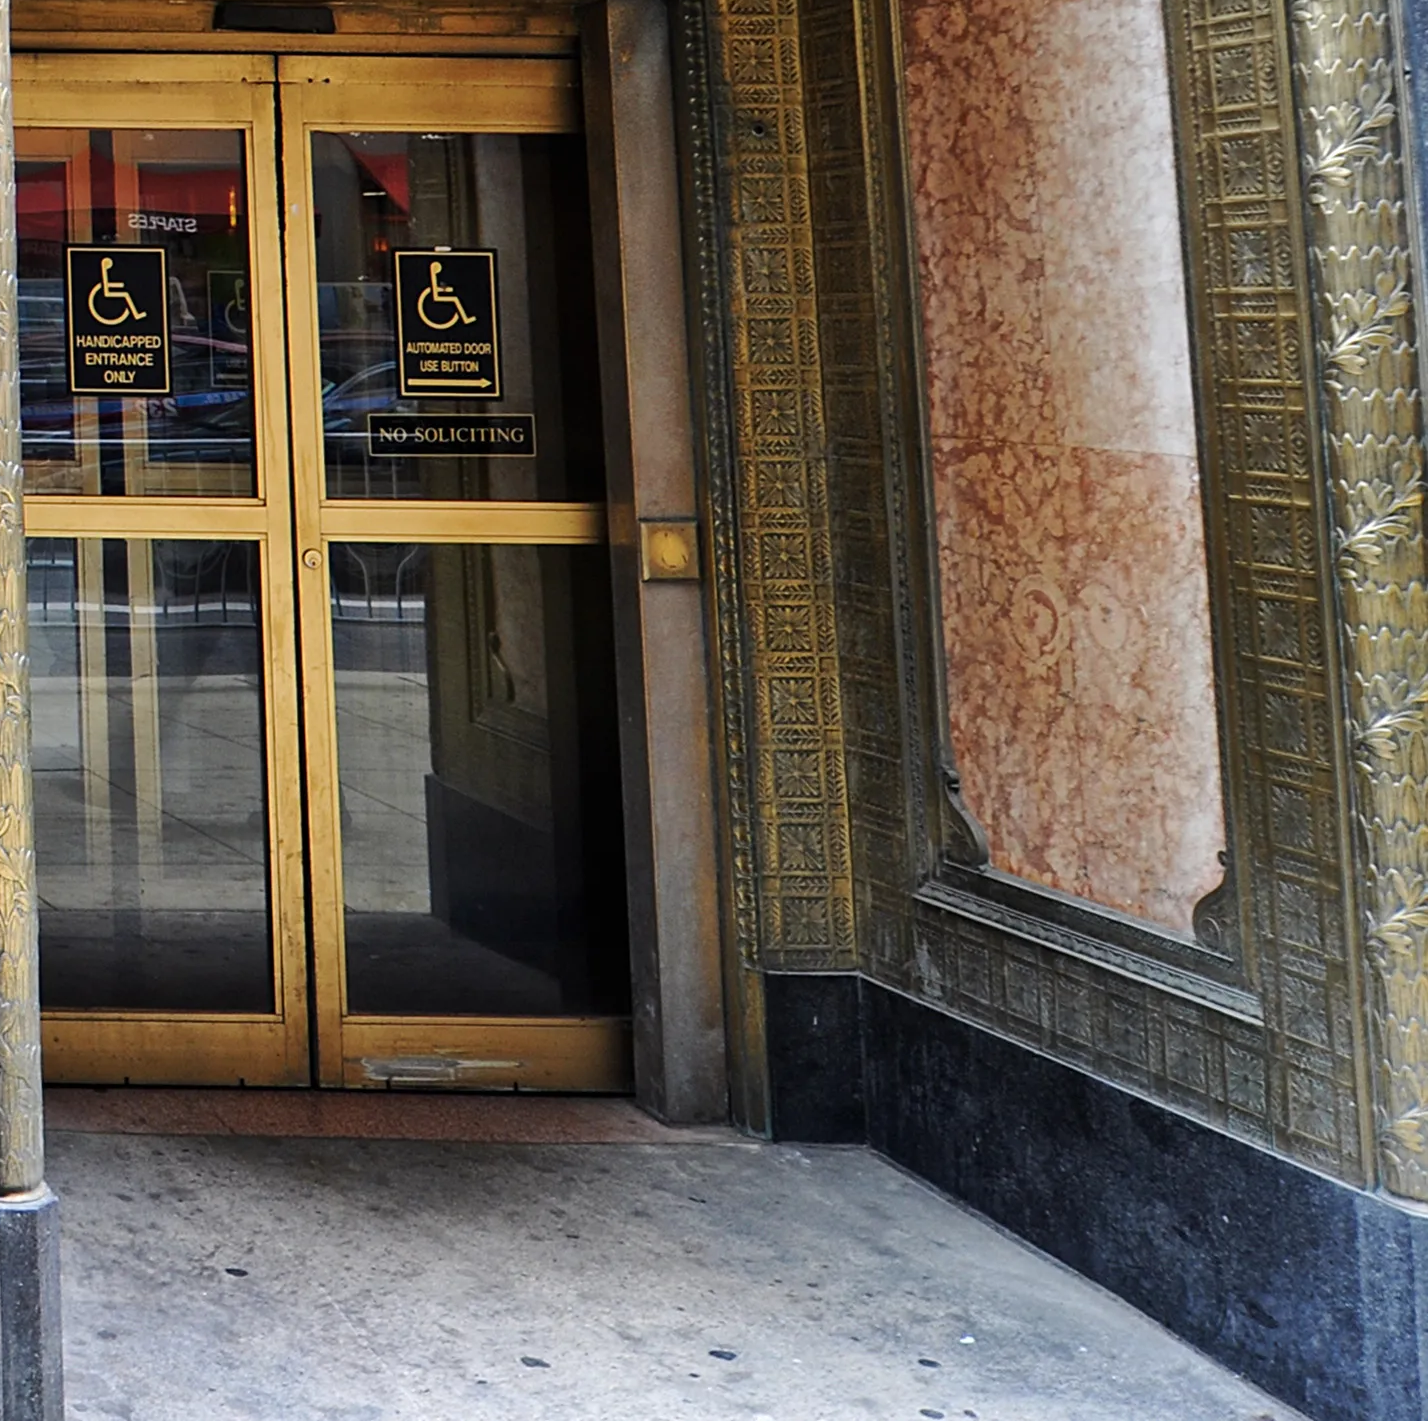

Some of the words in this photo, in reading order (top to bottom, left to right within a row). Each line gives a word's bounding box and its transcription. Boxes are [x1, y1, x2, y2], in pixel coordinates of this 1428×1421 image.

[76, 335, 162, 349] HANDICAPPED
[406, 342, 462, 354] AUTOMATED
[464, 343, 492, 355] DOOR
[85, 352, 154, 366] ENTRANCE
[420, 360, 439, 372] USE
[441, 360, 479, 373] BUTTON
[104, 370, 136, 384] ONLY
[379, 427, 408, 443] NO
[414, 427, 525, 443] SOLICITING
